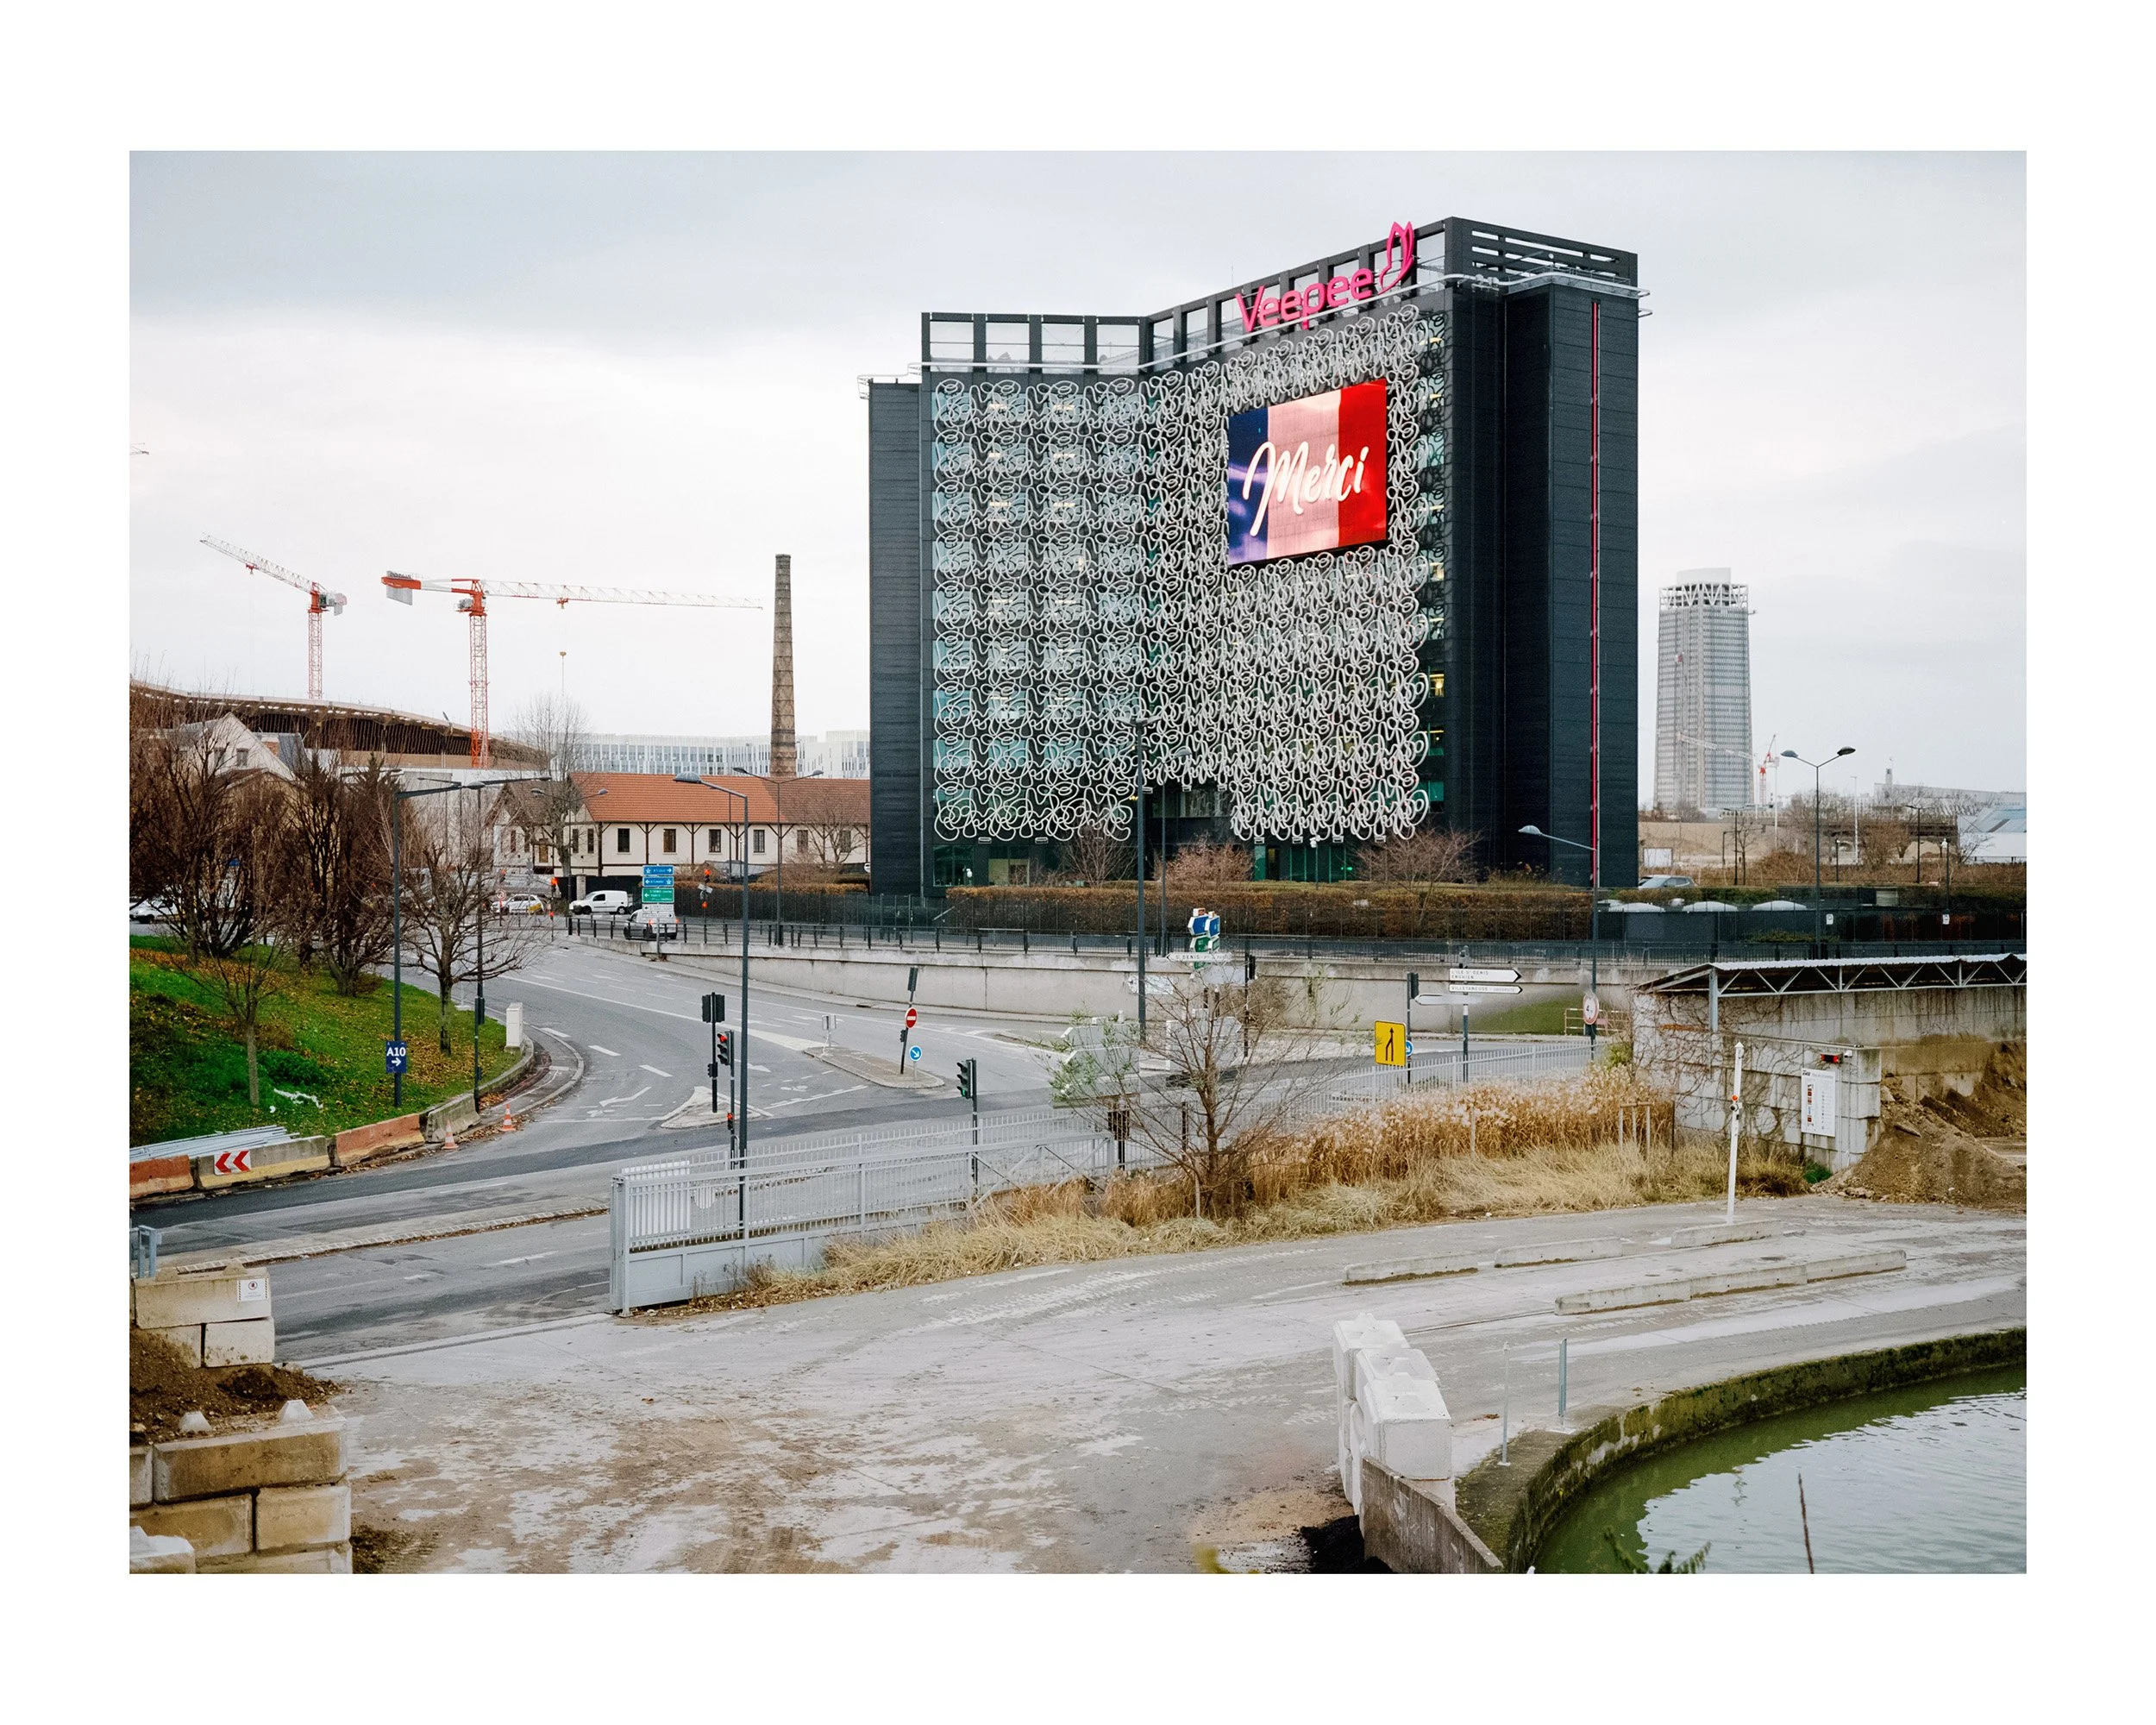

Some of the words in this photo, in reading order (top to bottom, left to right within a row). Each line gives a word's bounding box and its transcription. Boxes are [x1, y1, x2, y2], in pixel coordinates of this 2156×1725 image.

[1235, 267, 1375, 332] Veepee
[1242, 441, 1369, 536] Merci
[386, 1047, 406, 1057] A10
